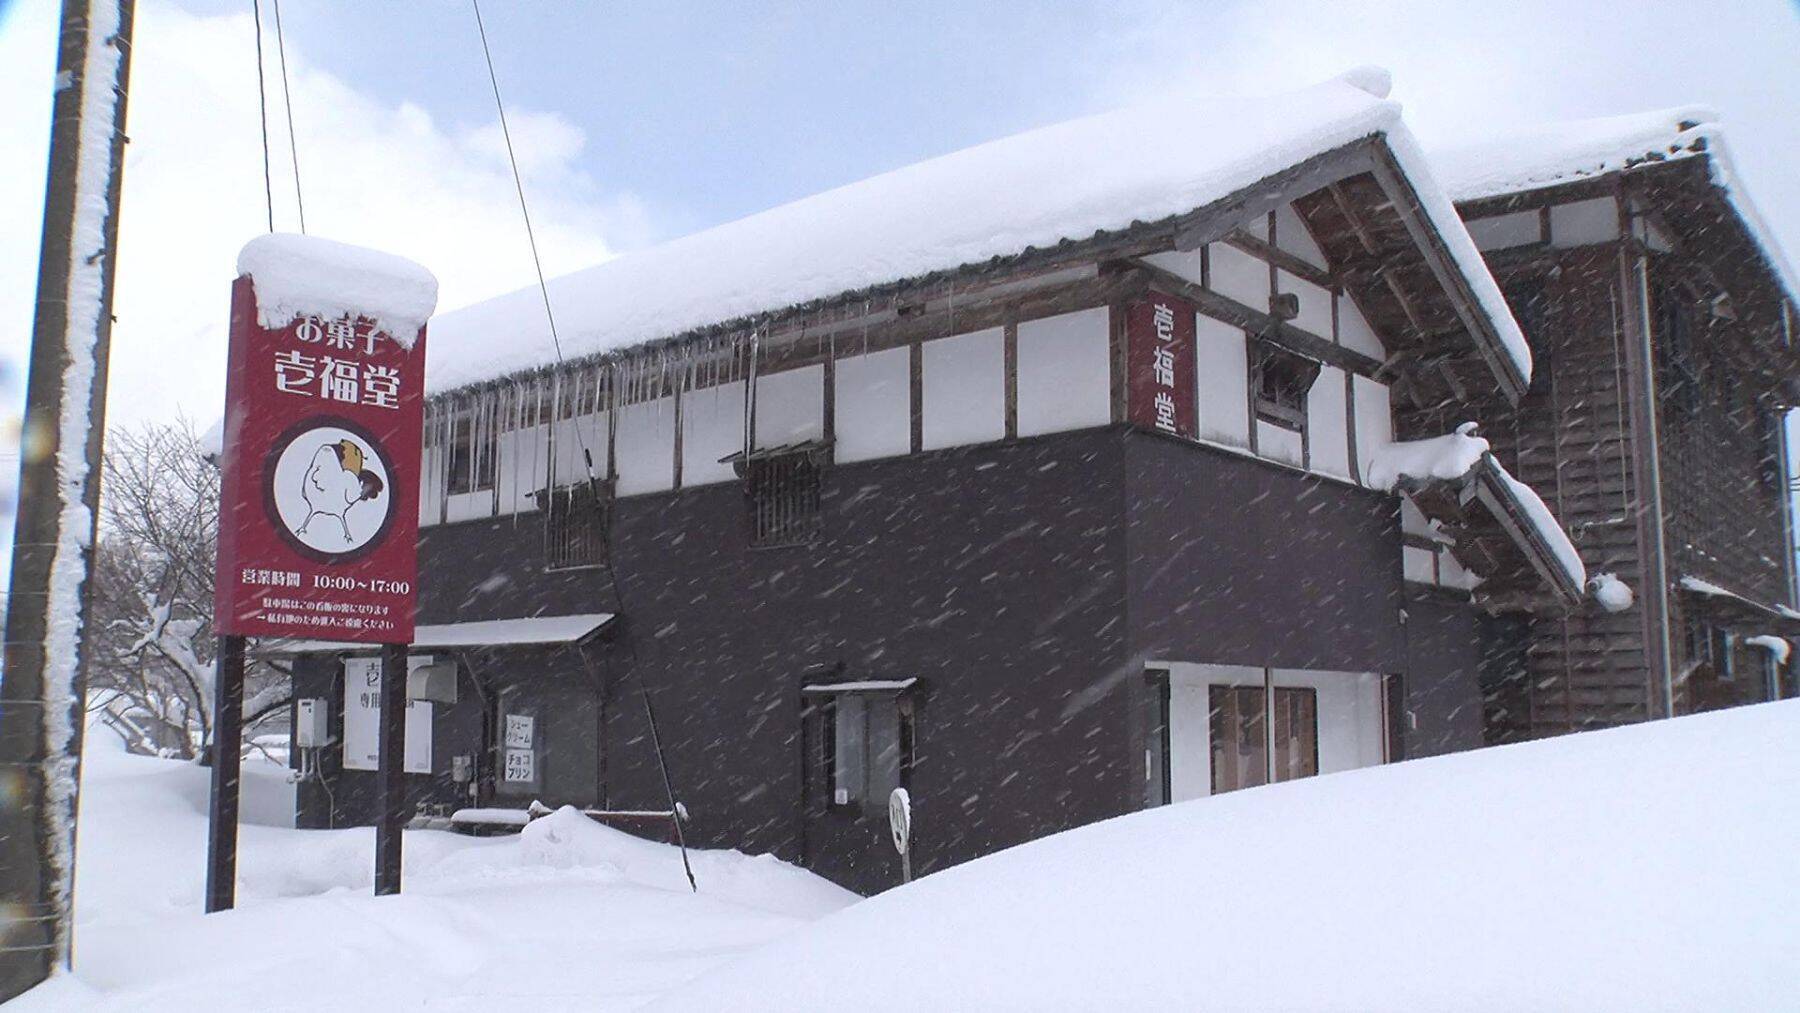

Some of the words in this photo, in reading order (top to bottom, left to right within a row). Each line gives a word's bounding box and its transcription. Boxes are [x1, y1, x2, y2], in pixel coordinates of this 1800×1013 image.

[295, 314, 385, 355] お菓子
[275, 350, 400, 409] 壱福堂
[1153, 303, 1176, 433] 壱福堂
[242, 568, 300, 588] 営業時間
